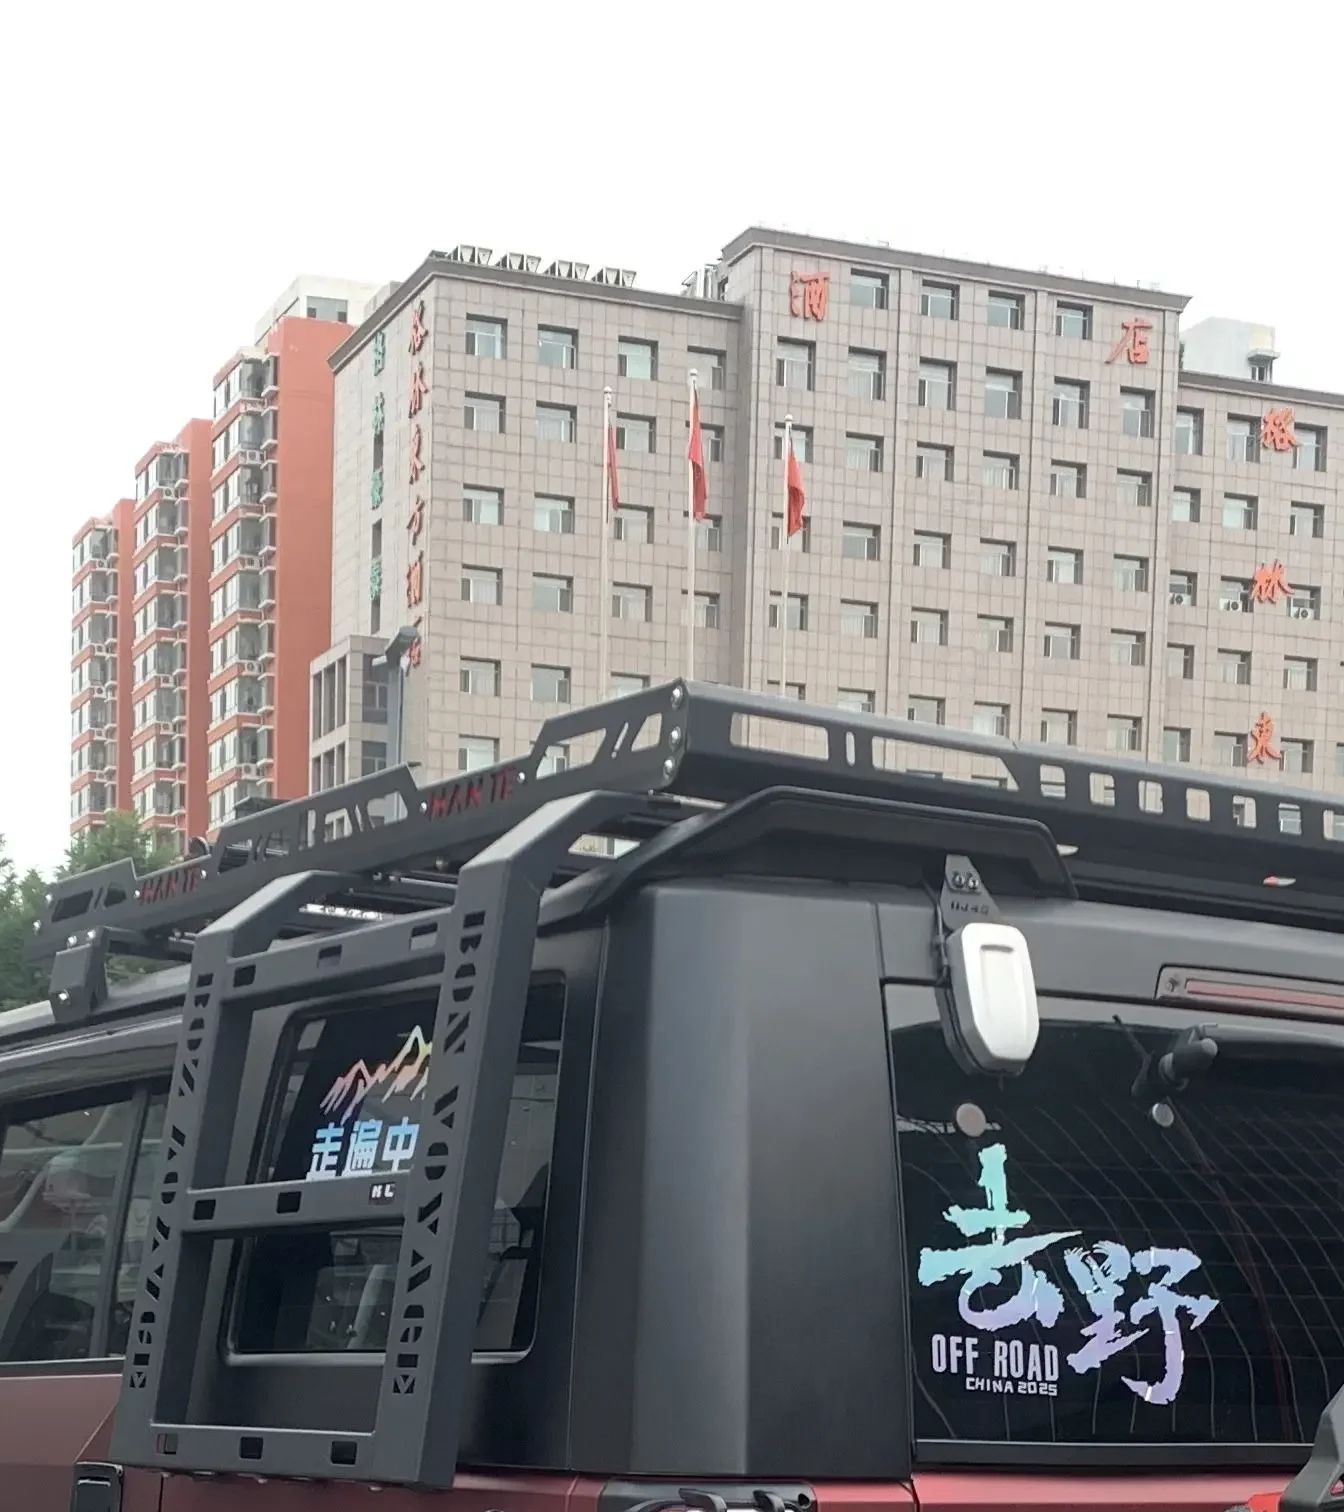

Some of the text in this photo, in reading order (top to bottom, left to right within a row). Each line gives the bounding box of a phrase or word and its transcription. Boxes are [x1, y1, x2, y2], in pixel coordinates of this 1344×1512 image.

[931, 1333, 1059, 1382] OFF ROAD
[965, 1377, 1058, 1397] CHINA 2025
